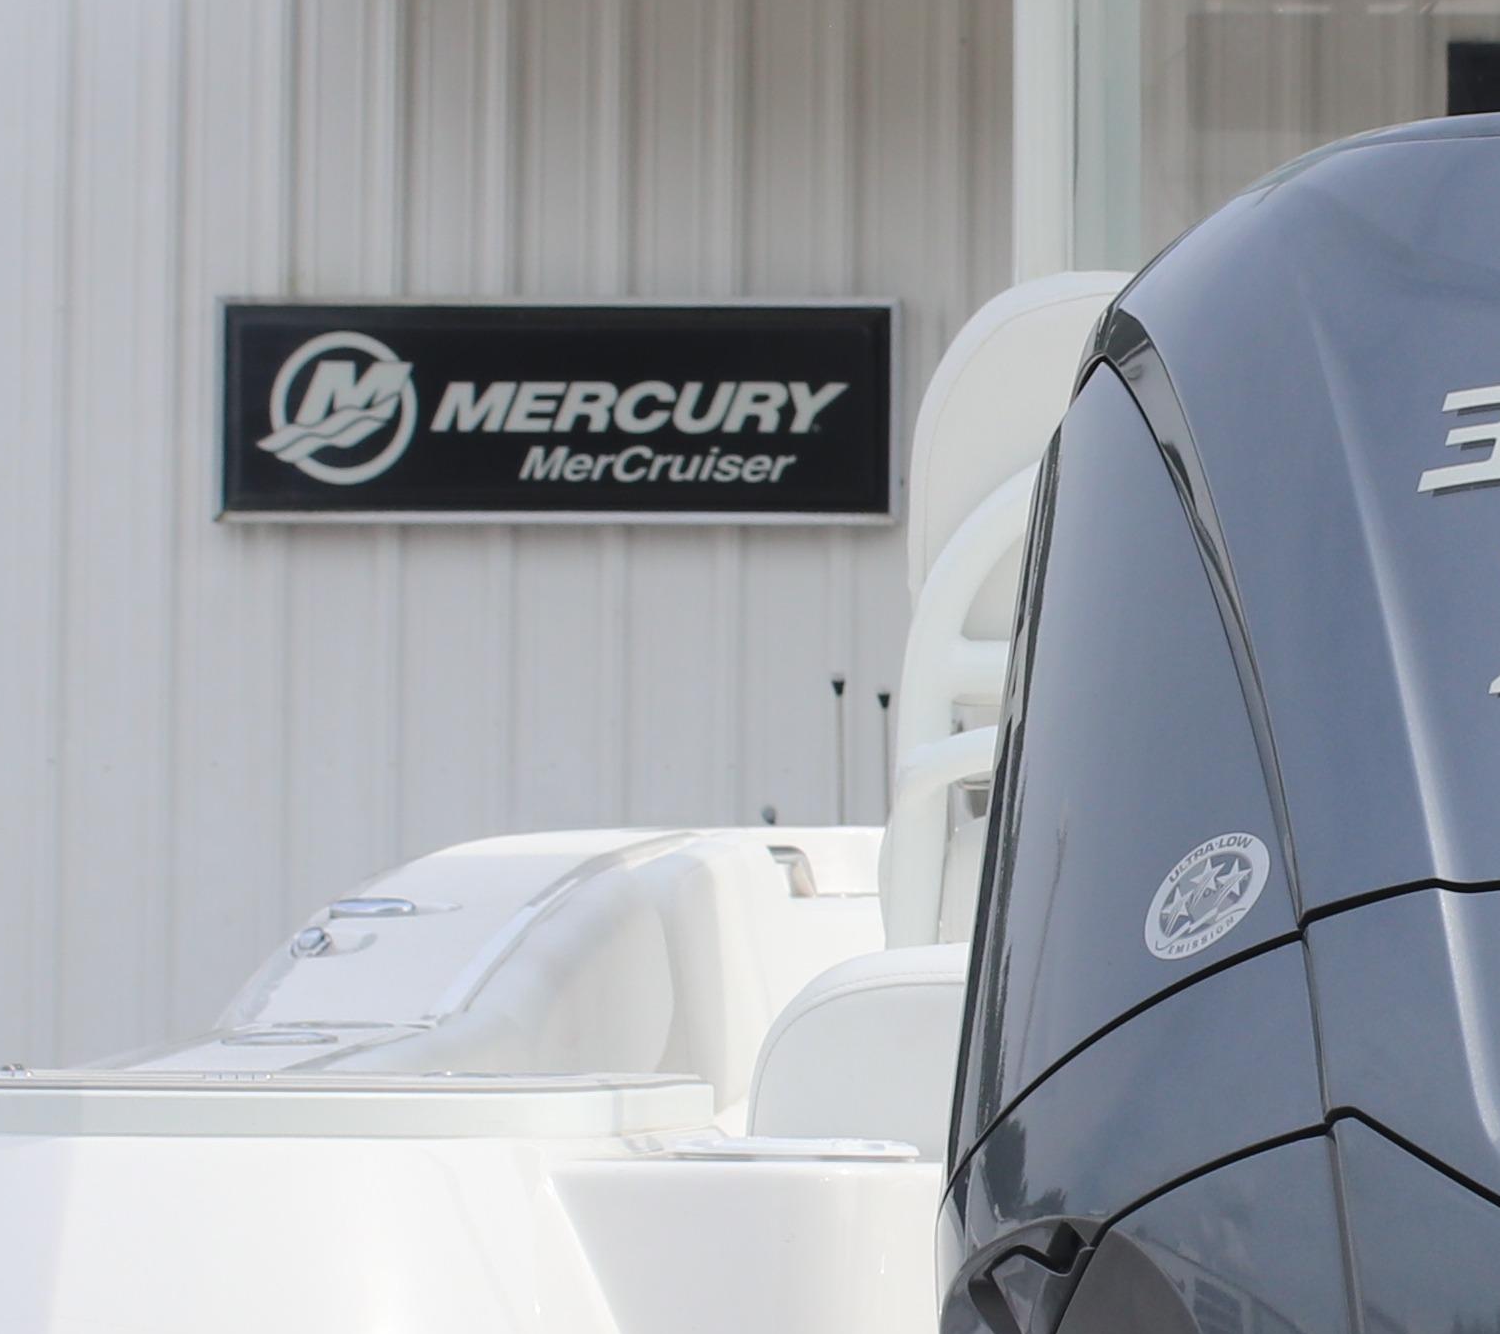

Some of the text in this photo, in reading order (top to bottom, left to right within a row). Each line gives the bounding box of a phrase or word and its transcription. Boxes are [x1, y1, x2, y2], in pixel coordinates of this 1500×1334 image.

[430, 381, 848, 433] MERCURY
[519, 445, 796, 483] MerCruiser
[1168, 916, 1234, 955] EMISSION
